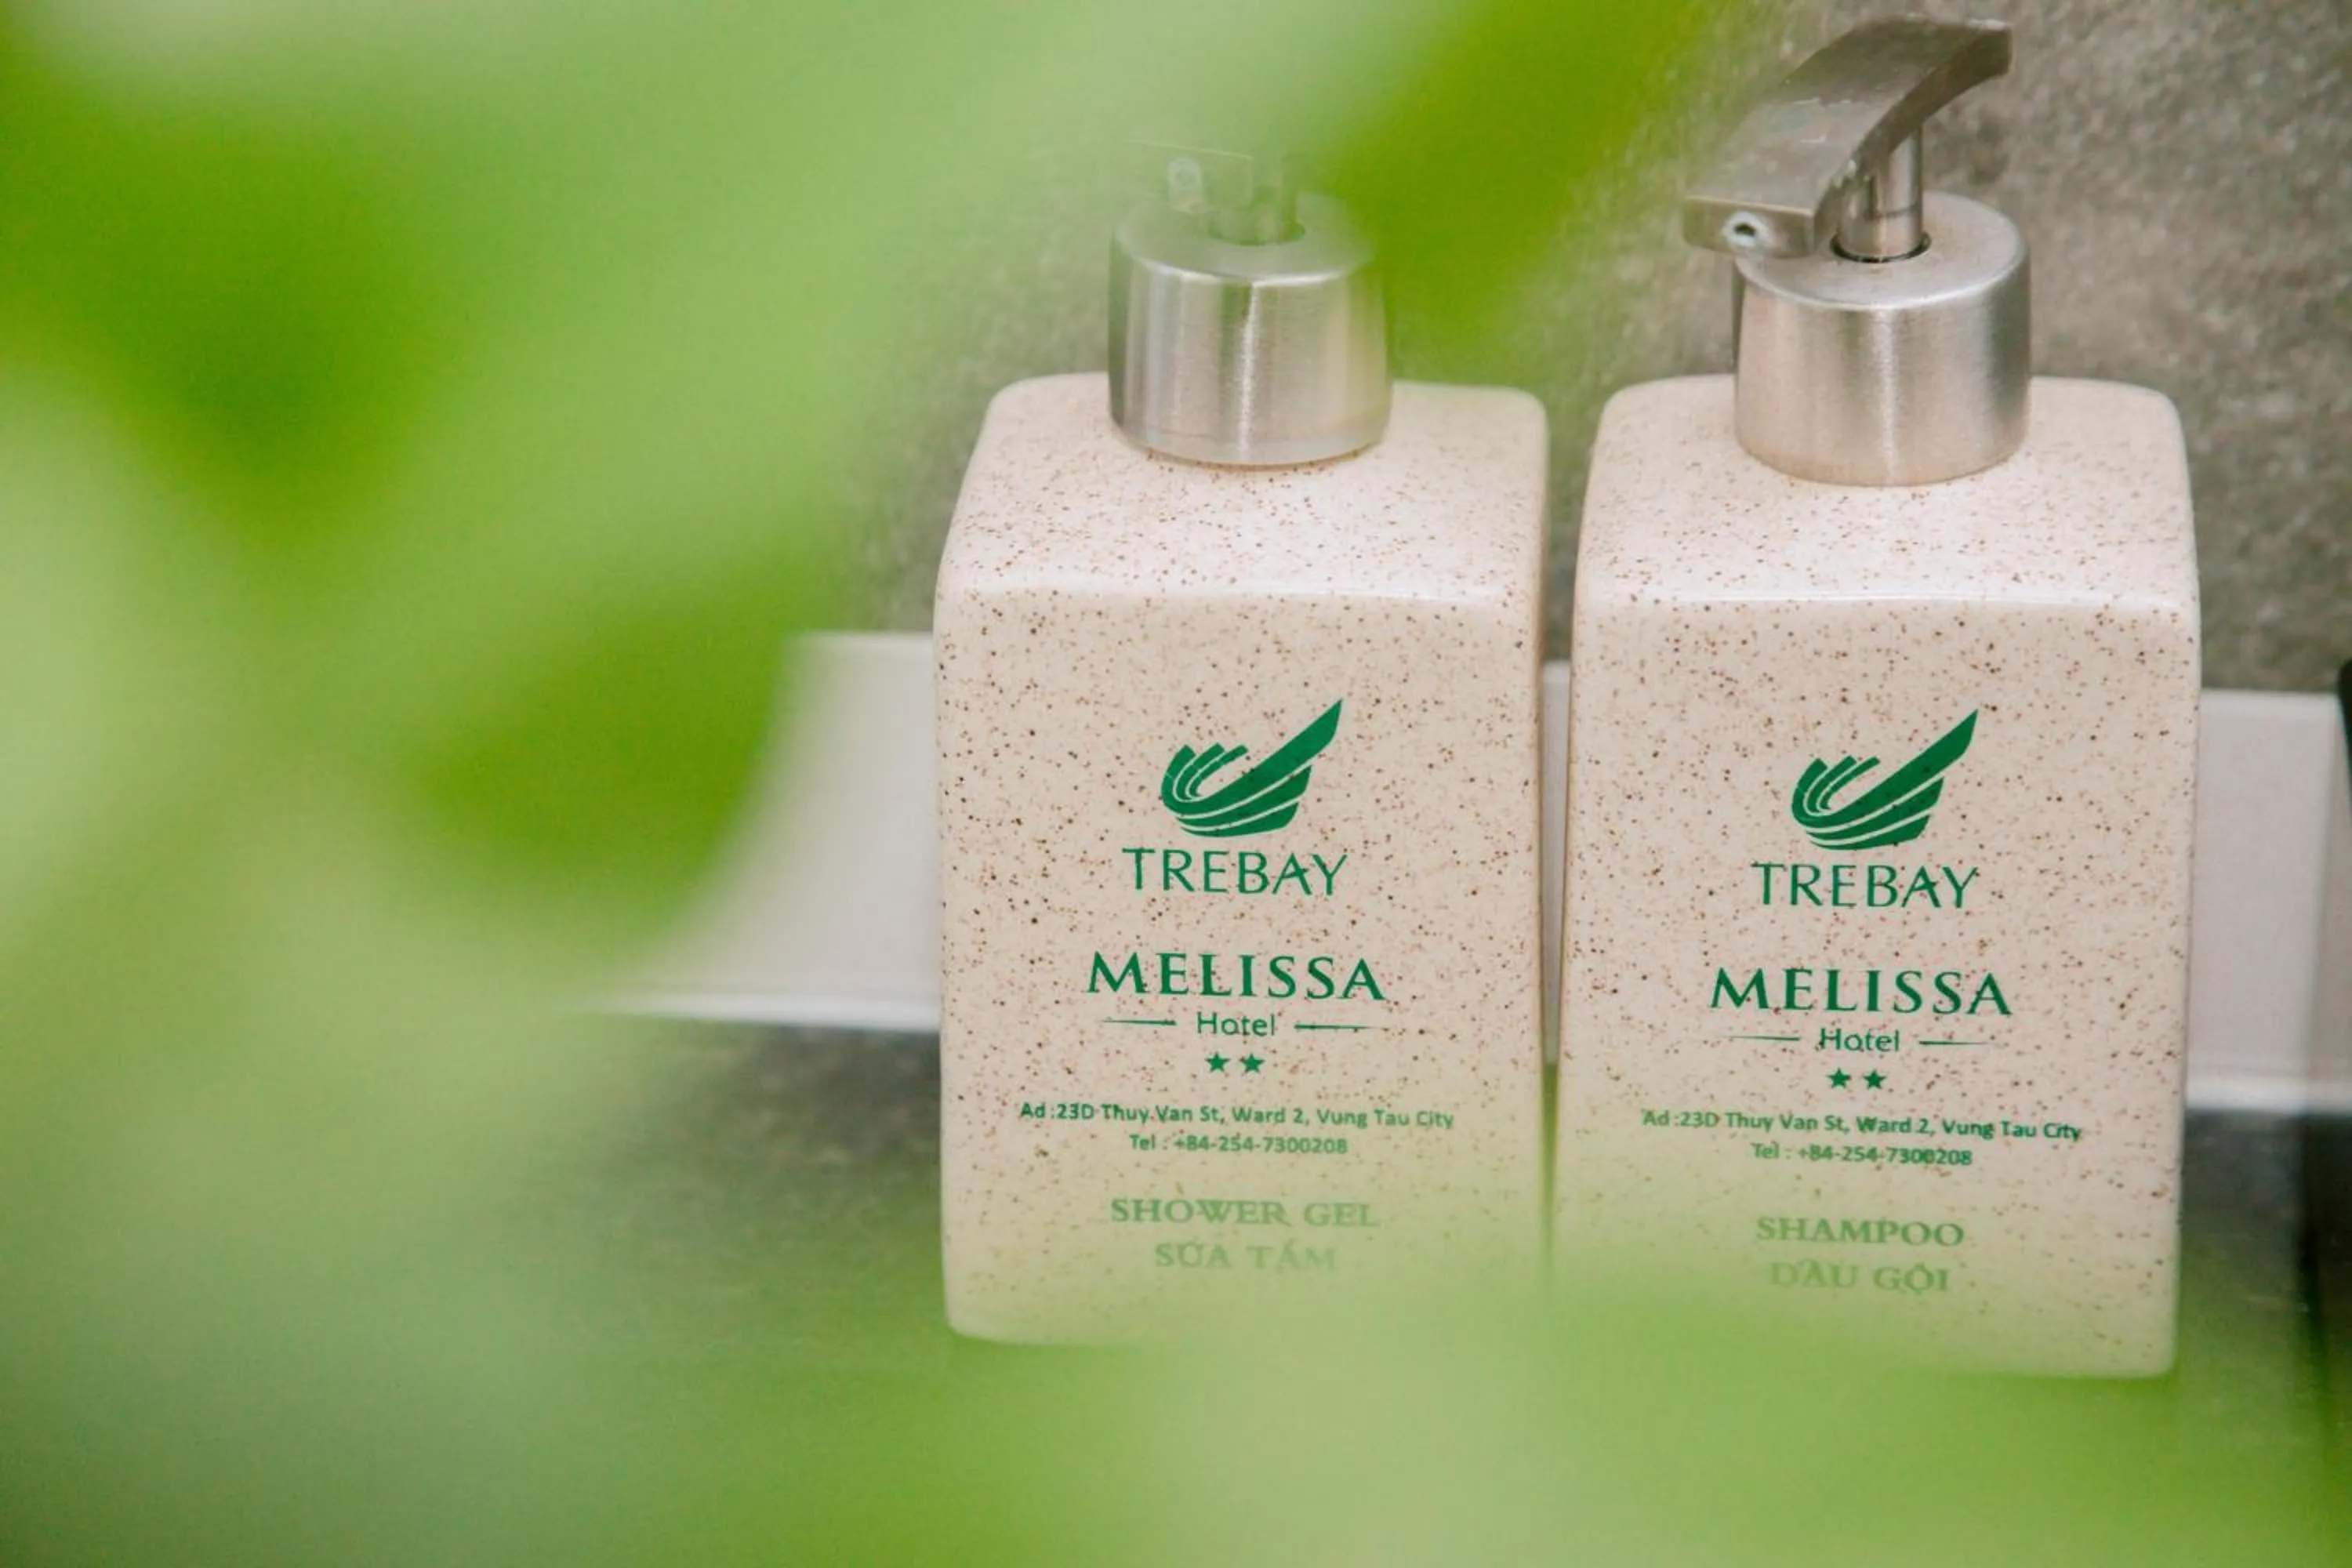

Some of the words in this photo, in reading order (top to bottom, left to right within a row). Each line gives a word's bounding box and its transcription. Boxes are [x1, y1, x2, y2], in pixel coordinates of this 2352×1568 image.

[1122, 848, 1348, 895] TREBAY
[1751, 862, 1979, 908] TREBAY
[1087, 951, 1386, 1001] MELISSA
[1710, 967, 2013, 1015] MELISSA
[1196, 1012, 1276, 1036] Hotel
[1820, 1028, 1900, 1052] Hotel
[1021, 1102, 1046, 1120] Ad
[1100, 1104, 1149, 1124] Thuy
[1155, 1105, 1192, 1123] Van
[1232, 1106, 1287, 1123] Ward
[1317, 1109, 1368, 1128] Vung
[1374, 1109, 1410, 1126] Tau
[1417, 1110, 1454, 1129] City
[1643, 1110, 1670, 1127] Ad
[1725, 1112, 1773, 1133] Thuy
[1779, 1113, 1818, 1131] Van
[1857, 1116, 1911, 1133] Ward
[1941, 1120, 1994, 1139] Vung
[2001, 1122, 2036, 1138] Tau
[2043, 1123, 2082, 1142] City
[1130, 1134, 1156, 1150] Tel
[1174, 1134, 1347, 1153] +84-254-7300208
[1751, 1142, 1779, 1159] Tel
[1798, 1144, 1972, 1165] +84-254-7300208
[1111, 1198, 1291, 1226] SHOWER
[1303, 1201, 1381, 1227] GEL
[1756, 1217, 1964, 1247] SHAMPOO
